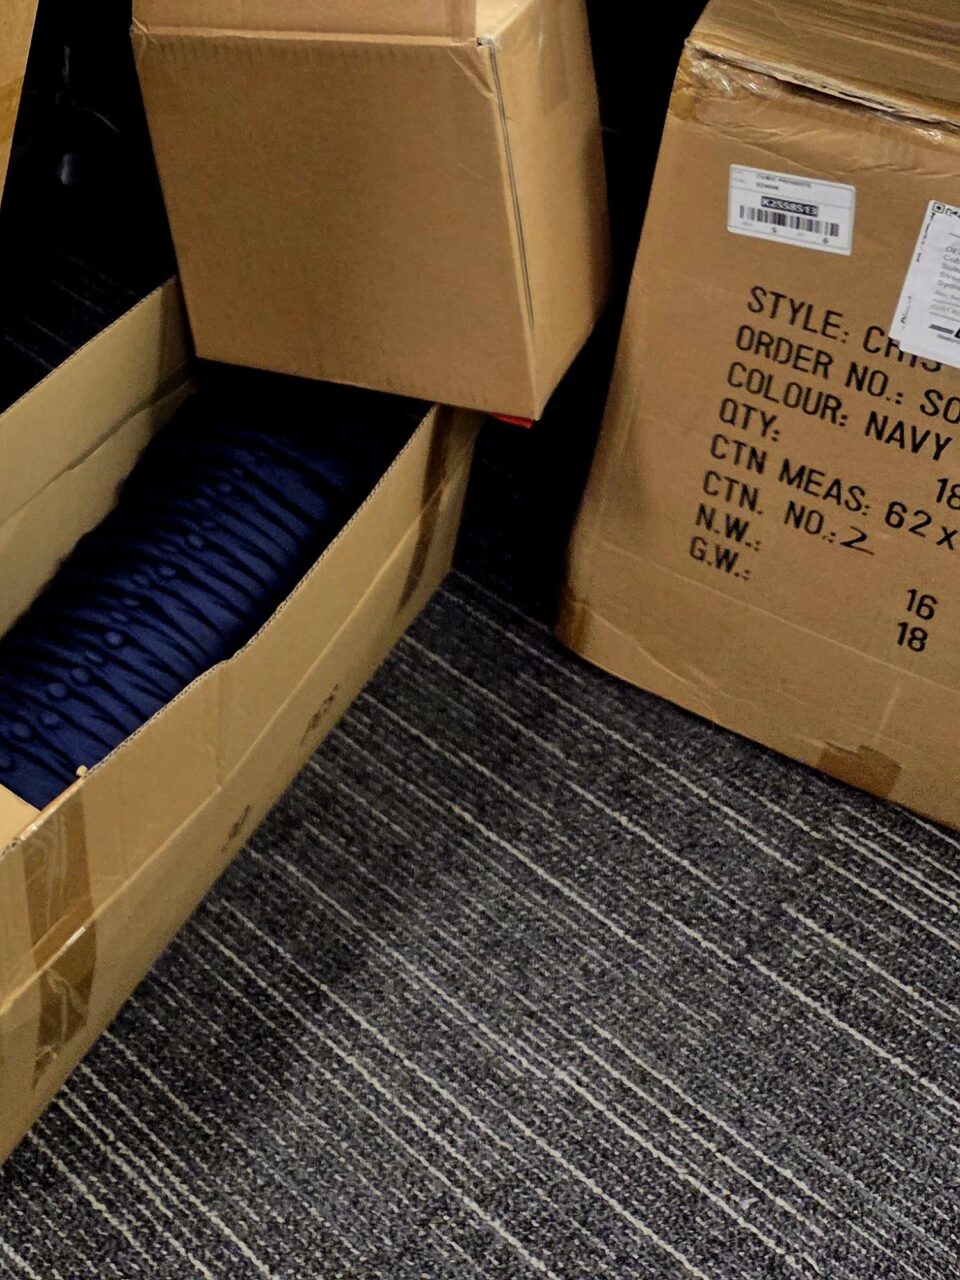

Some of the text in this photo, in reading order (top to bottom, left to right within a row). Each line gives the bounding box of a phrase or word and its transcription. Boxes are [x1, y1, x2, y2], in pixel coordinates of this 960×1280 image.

[747, 286, 850, 344] STYLE:
[735, 324, 835, 380] ORDER
[844, 361, 904, 406] NO.:
[718, 397, 781, 443] QTY:
[727, 361, 954, 462] COLOUR: NAVY
[702, 470, 763, 516] CTN.
[783, 500, 837, 544] NO.:
[710, 433, 767, 475] CTN
[778, 458, 871, 517] MEAS:
[689, 535, 929, 653] G.W.: 18
[695, 502, 939, 621] N.W.: 16
